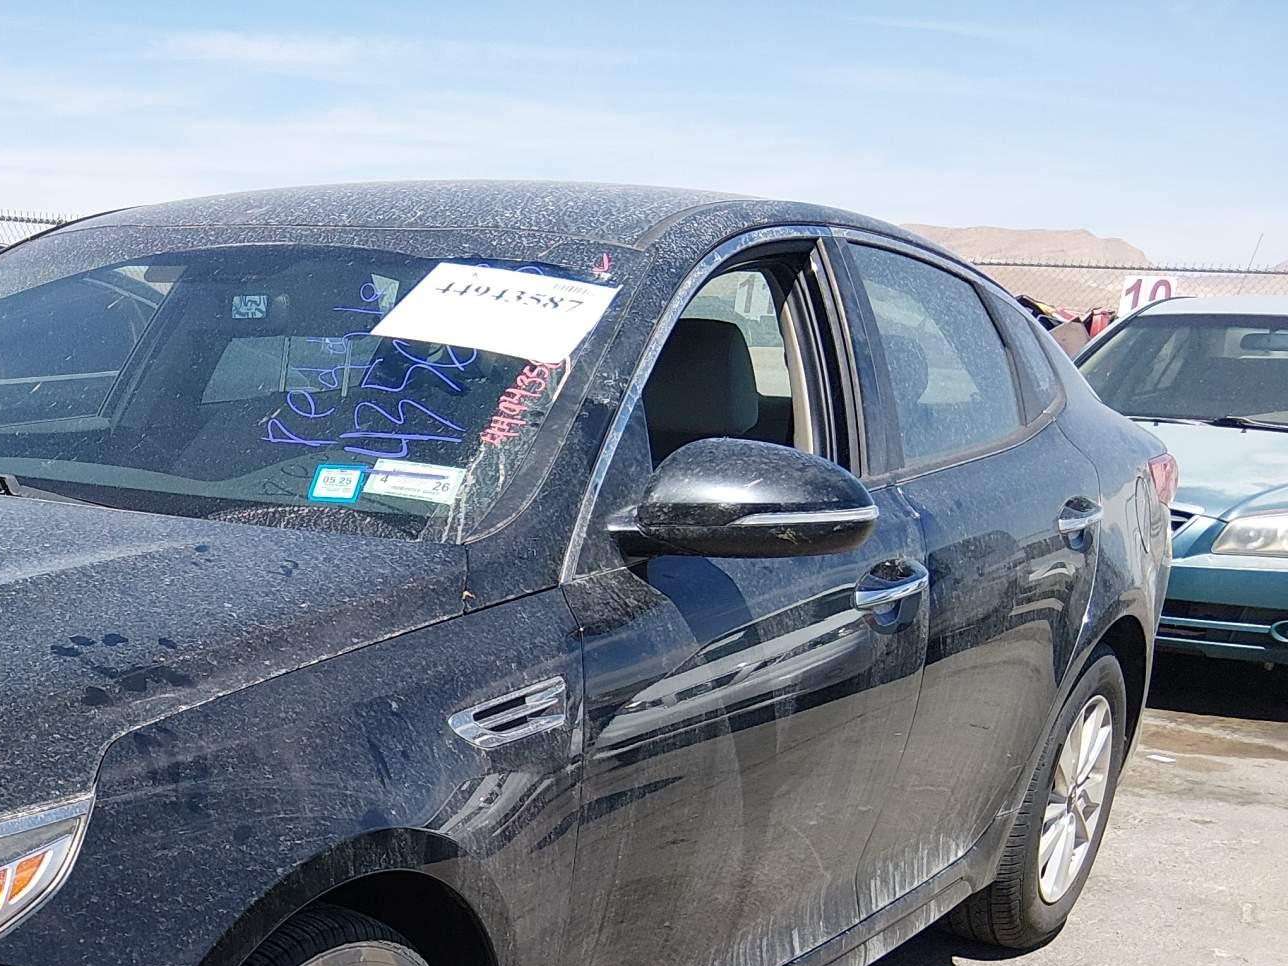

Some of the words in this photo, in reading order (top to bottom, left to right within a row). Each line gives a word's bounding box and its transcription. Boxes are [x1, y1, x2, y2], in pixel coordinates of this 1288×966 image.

[436, 280, 584, 312] 44943587
[1125, 279, 1171, 310] 10
[432, 482, 450, 493] 26
